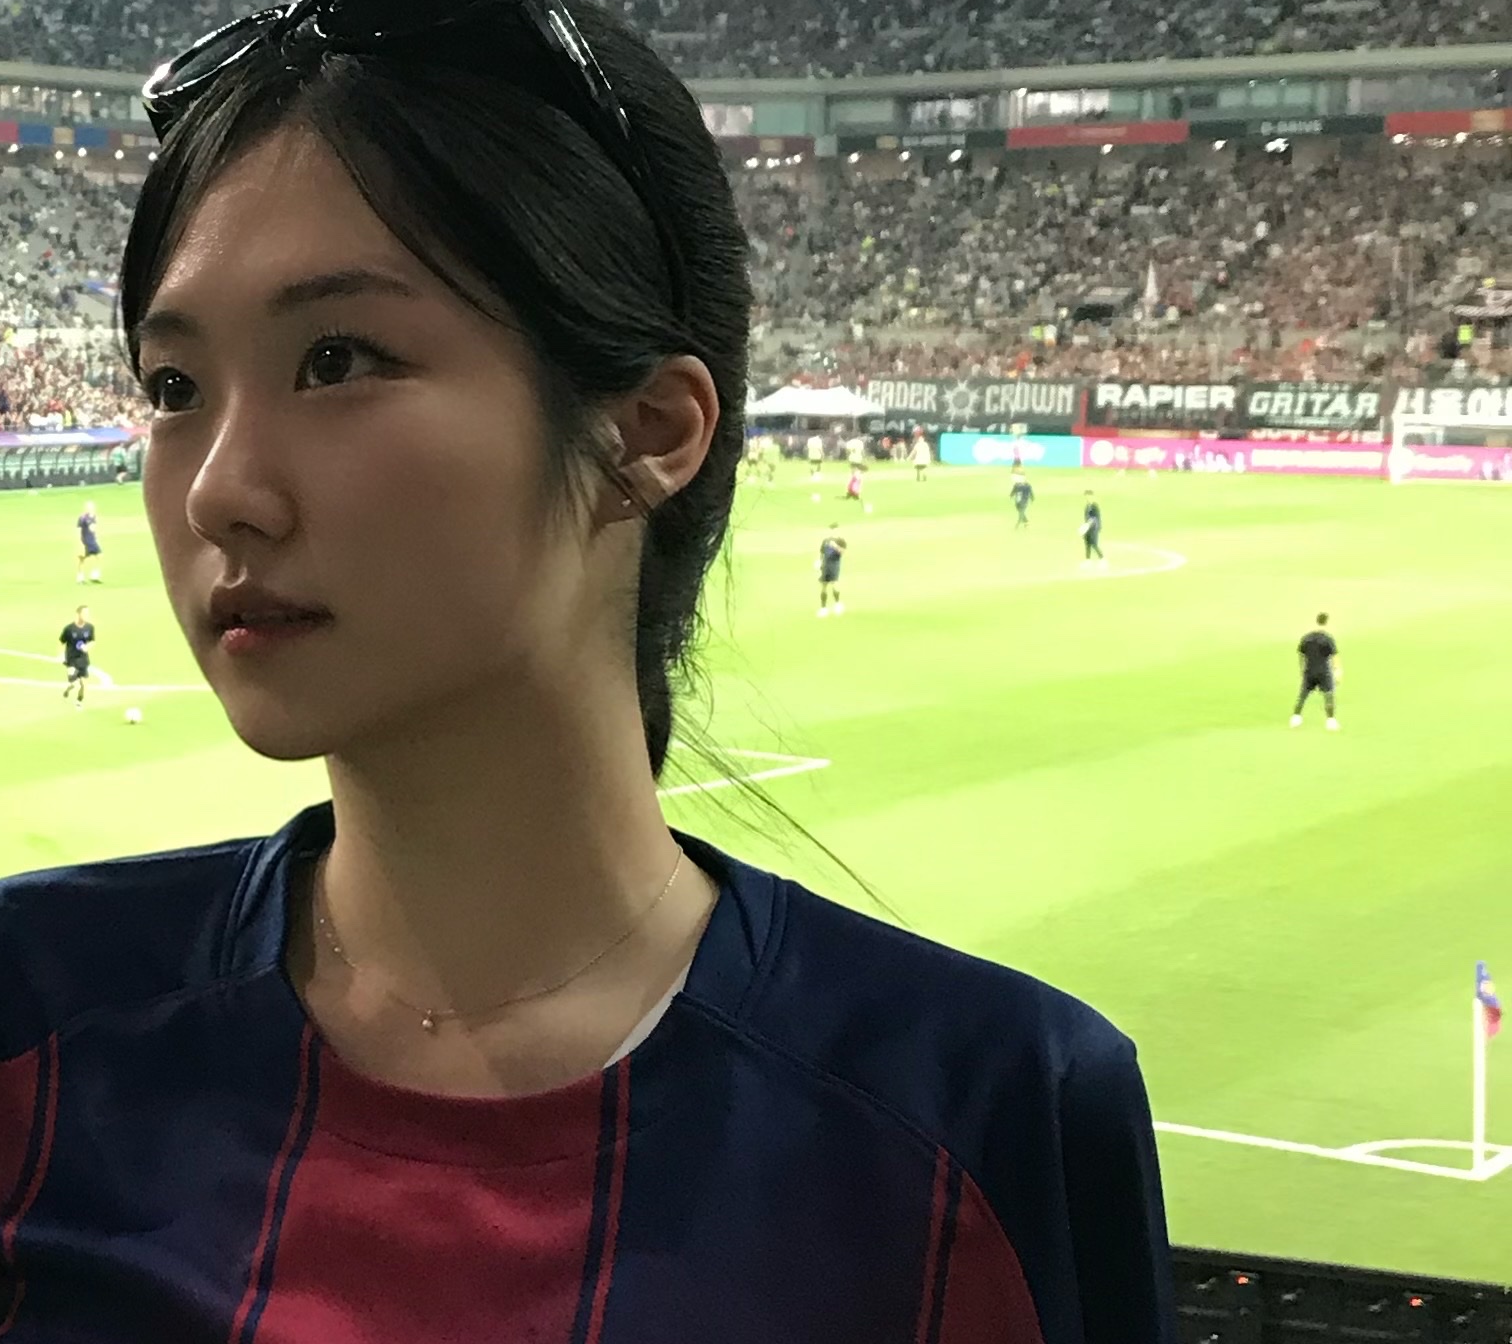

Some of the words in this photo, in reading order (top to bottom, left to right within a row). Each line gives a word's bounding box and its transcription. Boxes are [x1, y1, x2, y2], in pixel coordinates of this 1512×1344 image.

[985, 383, 1075, 414] CROWN
[1097, 383, 1236, 409] RAPIER
[1249, 391, 1380, 418] GRITAR
